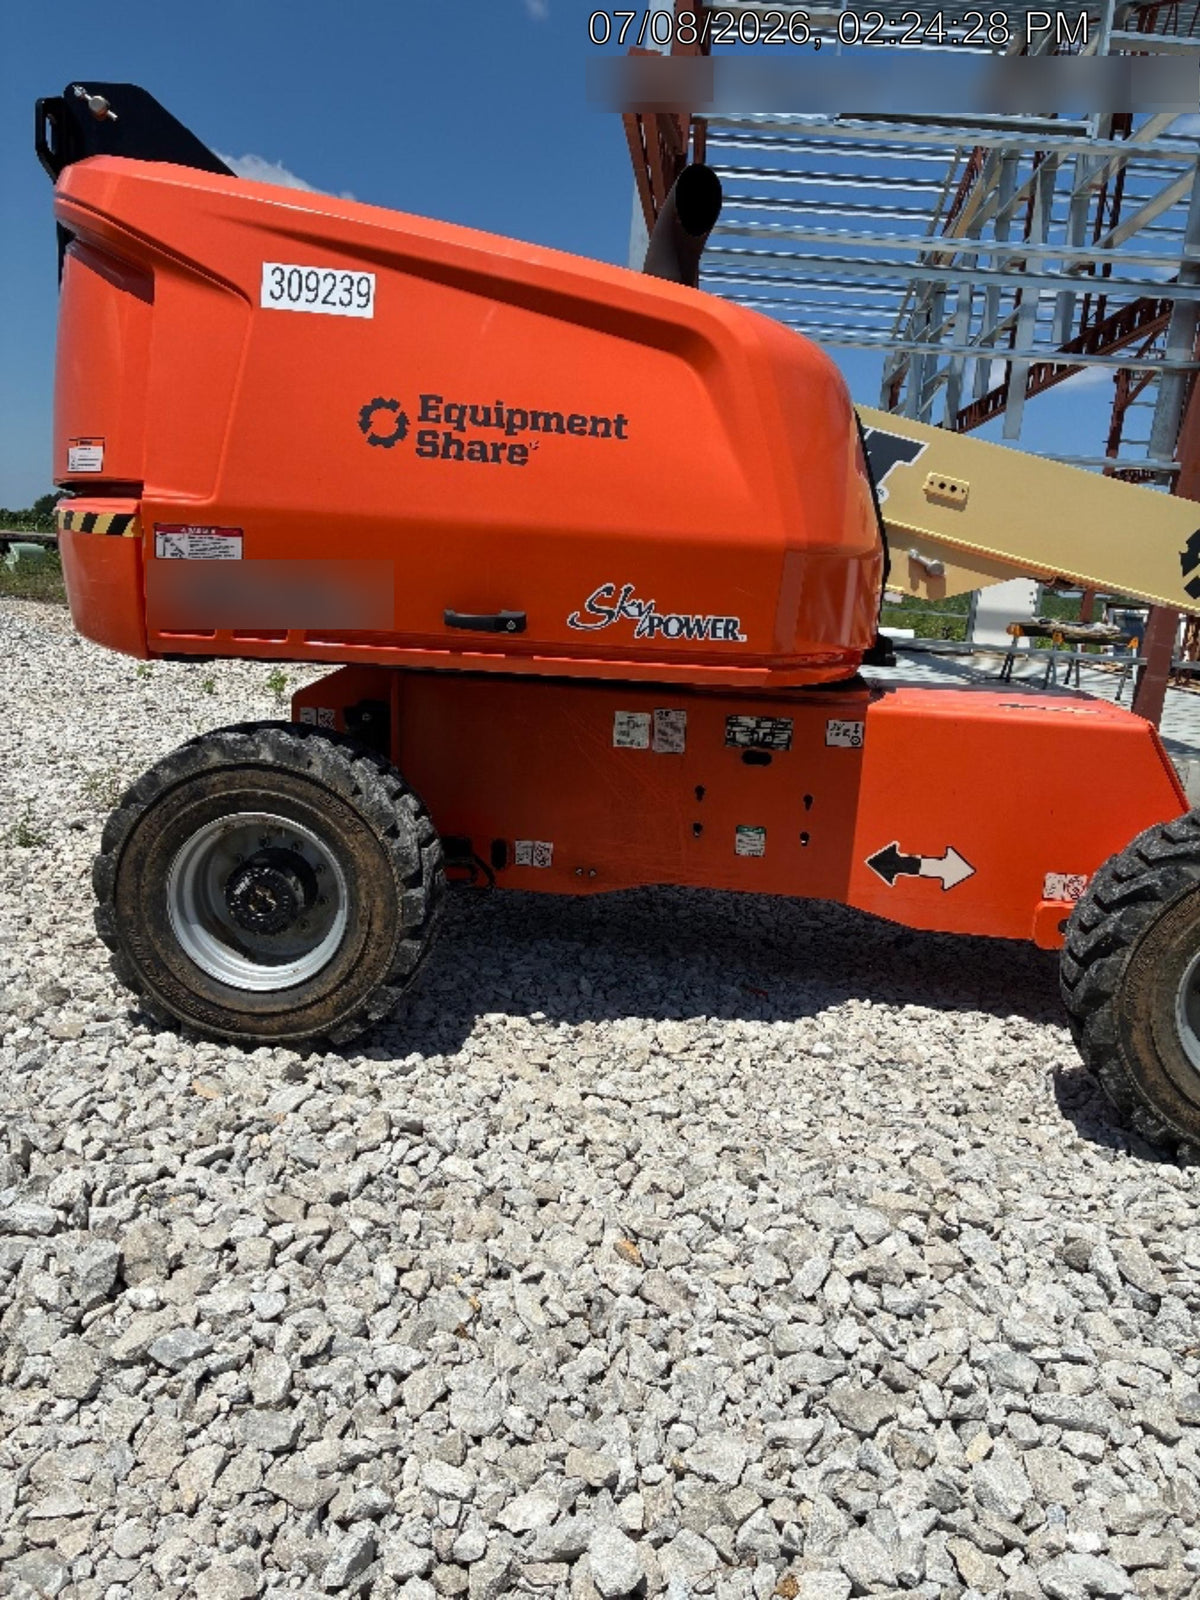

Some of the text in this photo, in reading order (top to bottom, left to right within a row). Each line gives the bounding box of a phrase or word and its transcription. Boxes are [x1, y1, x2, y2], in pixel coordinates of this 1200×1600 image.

[269, 266, 371, 308] 309239
[417, 394, 628, 439] Equipment
[416, 430, 529, 466] Share
